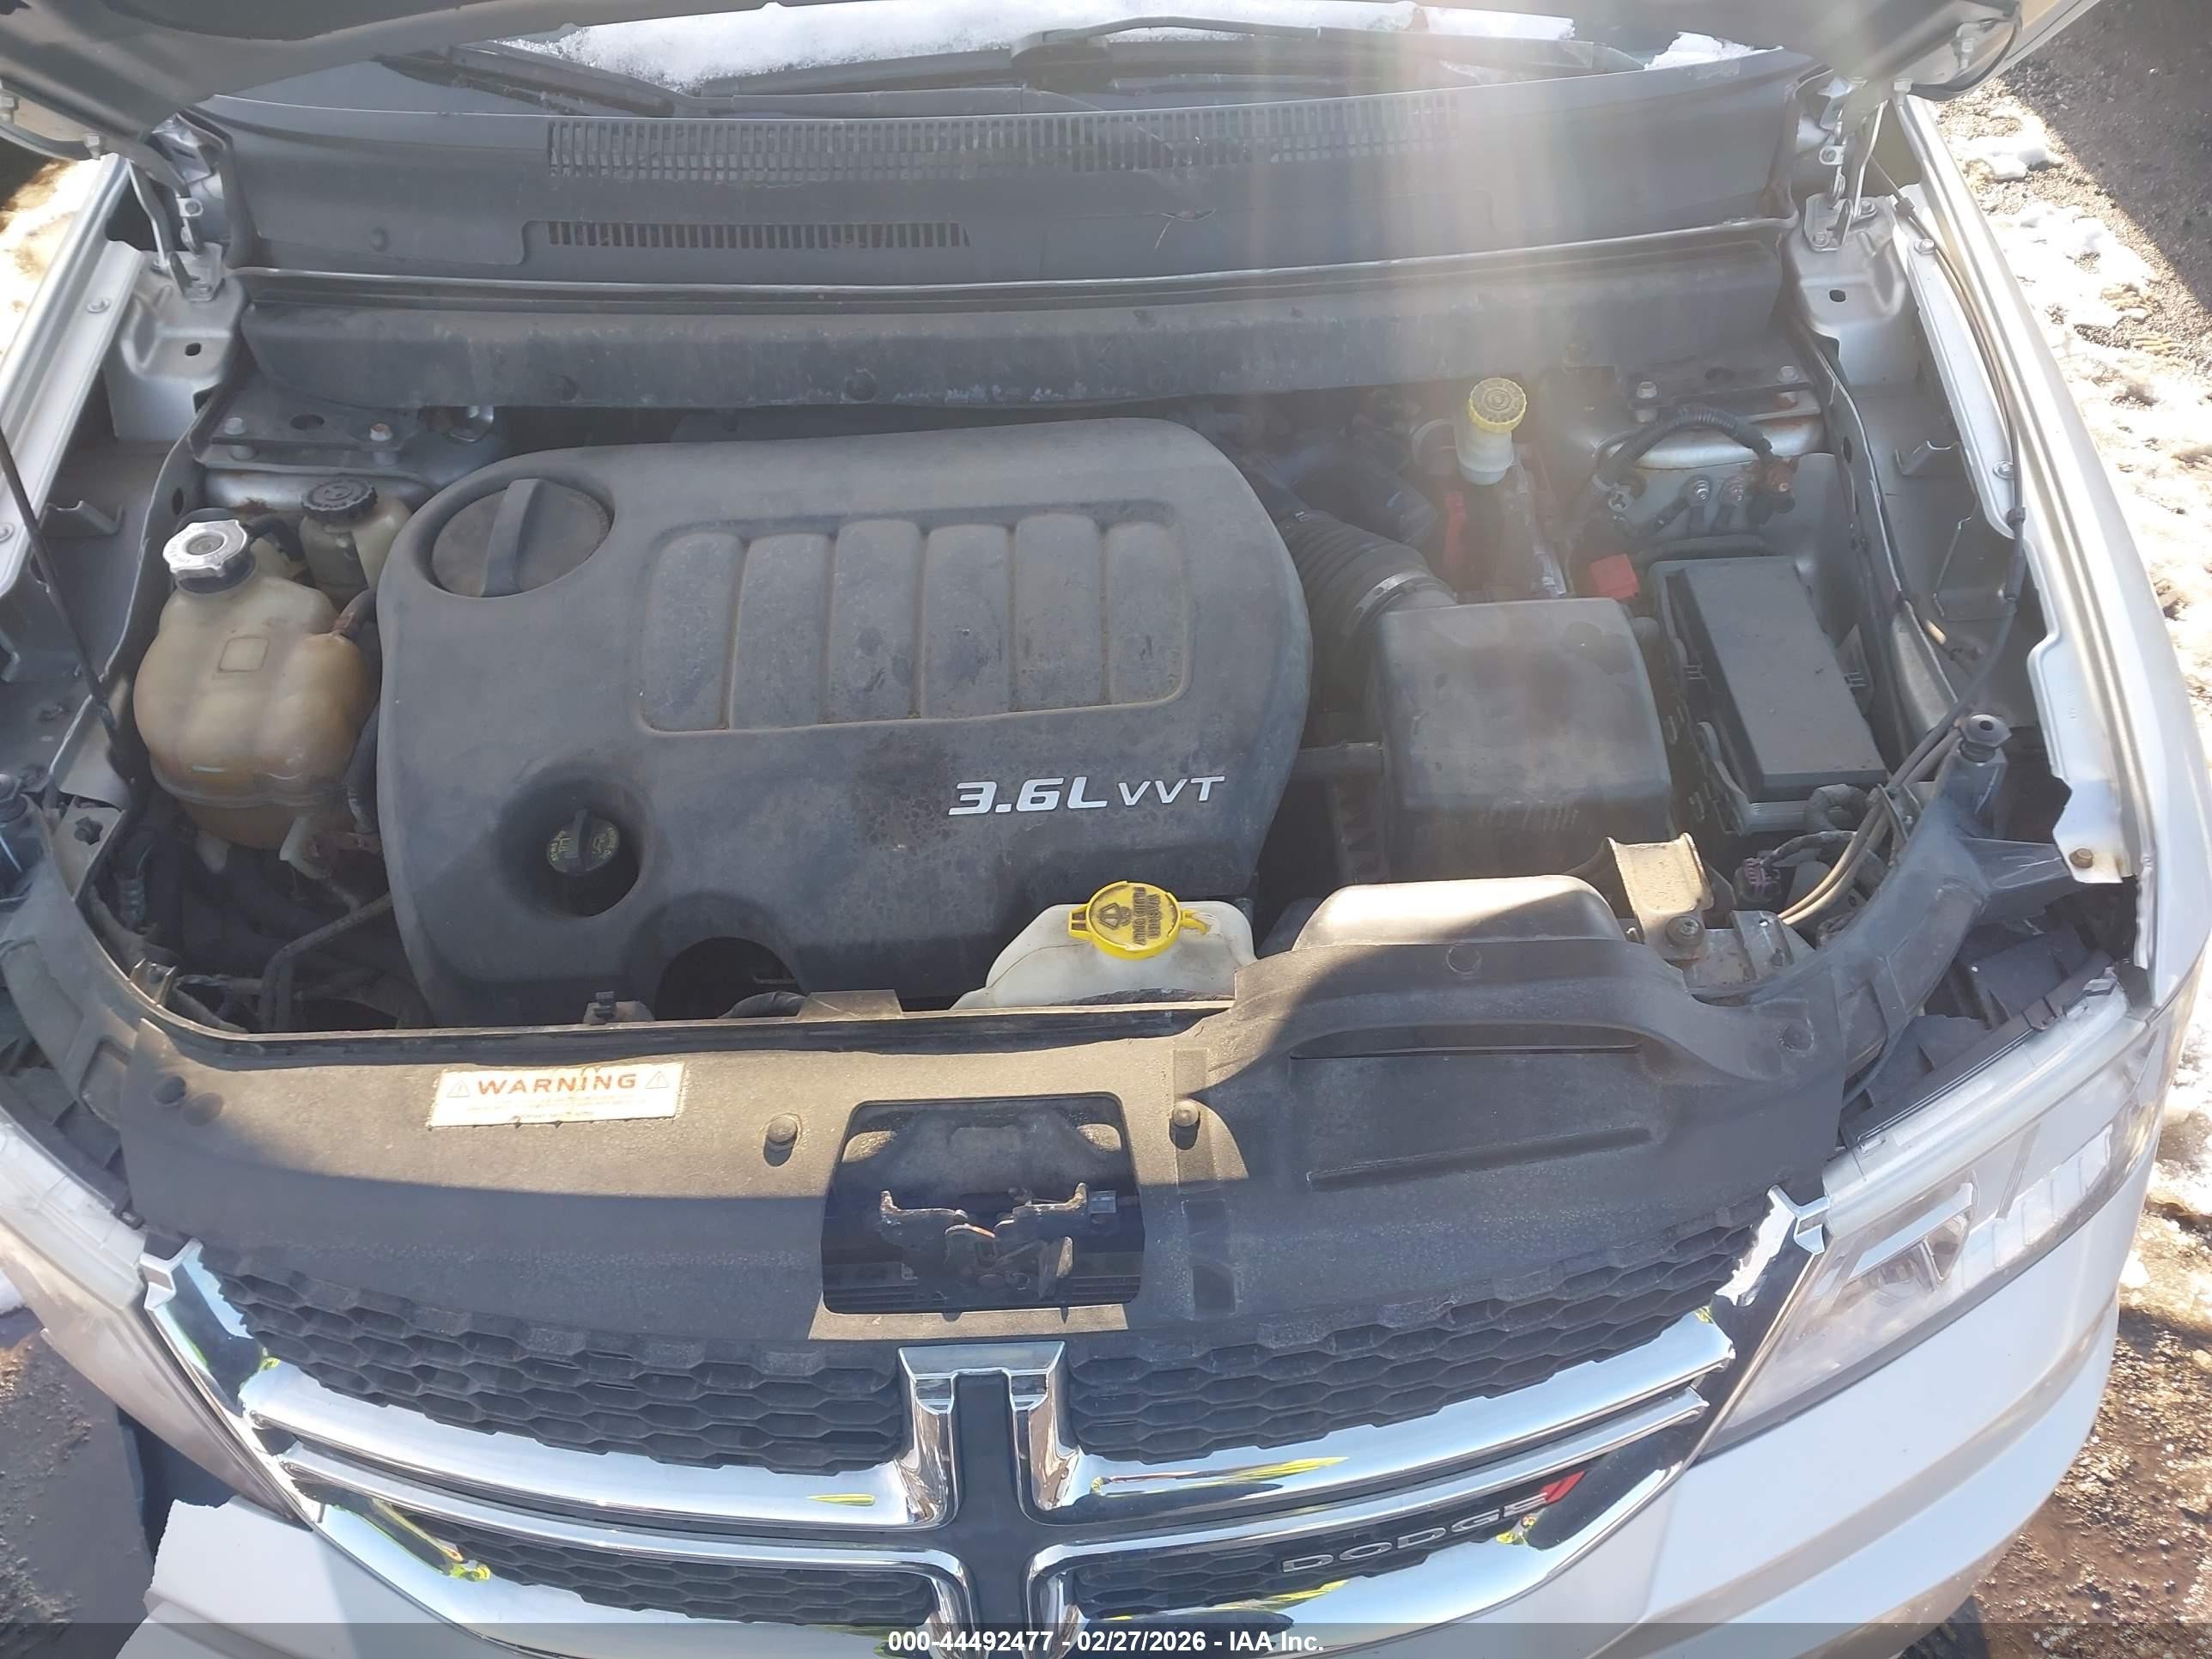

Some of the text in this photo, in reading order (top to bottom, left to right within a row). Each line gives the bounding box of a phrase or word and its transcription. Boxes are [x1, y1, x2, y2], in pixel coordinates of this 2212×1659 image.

[947, 775, 1225, 816] 3.6L VVT
[1133, 886, 1146, 945] FLUID ONLY
[1146, 893, 1162, 939] WASHER
[477, 1073, 637, 1095] WARNING
[1281, 1491, 1548, 1573] DODGE
